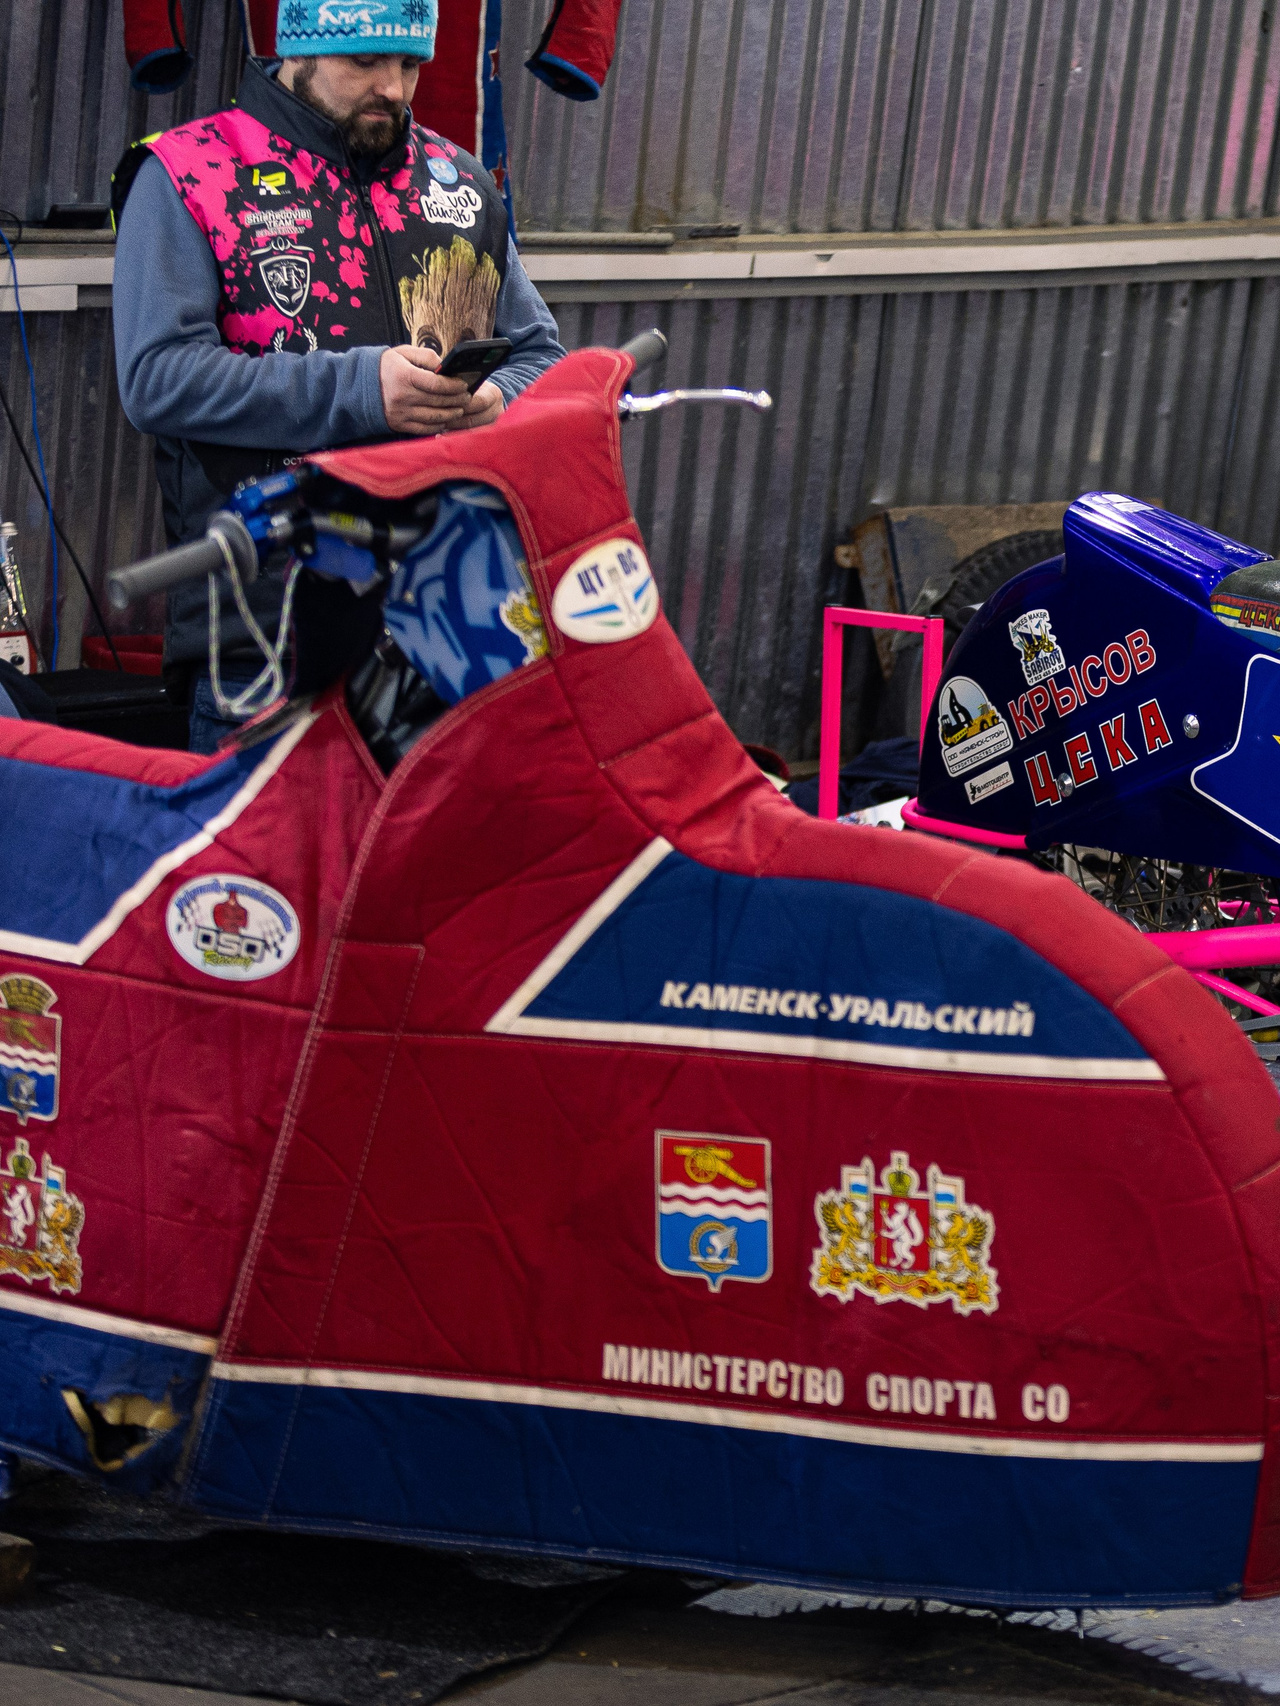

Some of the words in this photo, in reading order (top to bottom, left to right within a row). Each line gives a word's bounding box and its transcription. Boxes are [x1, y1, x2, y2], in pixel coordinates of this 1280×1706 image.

[1011, 616, 1028, 634] SPIKES
[1028, 611, 1048, 621] MAKER
[1008, 628, 1156, 740] КРЫСОВ
[1024, 650, 1062, 678] SABIROV
[1024, 698, 1173, 806] ЦСКА
[659, 981, 1036, 1037] КАМЕНСК-УРАЛЬСКИЙ
[603, 1343, 845, 1407] МИНИСТЕРСТВО
[866, 1372, 998, 1421] СПОРТА
[1022, 1384, 1070, 1423] СО
